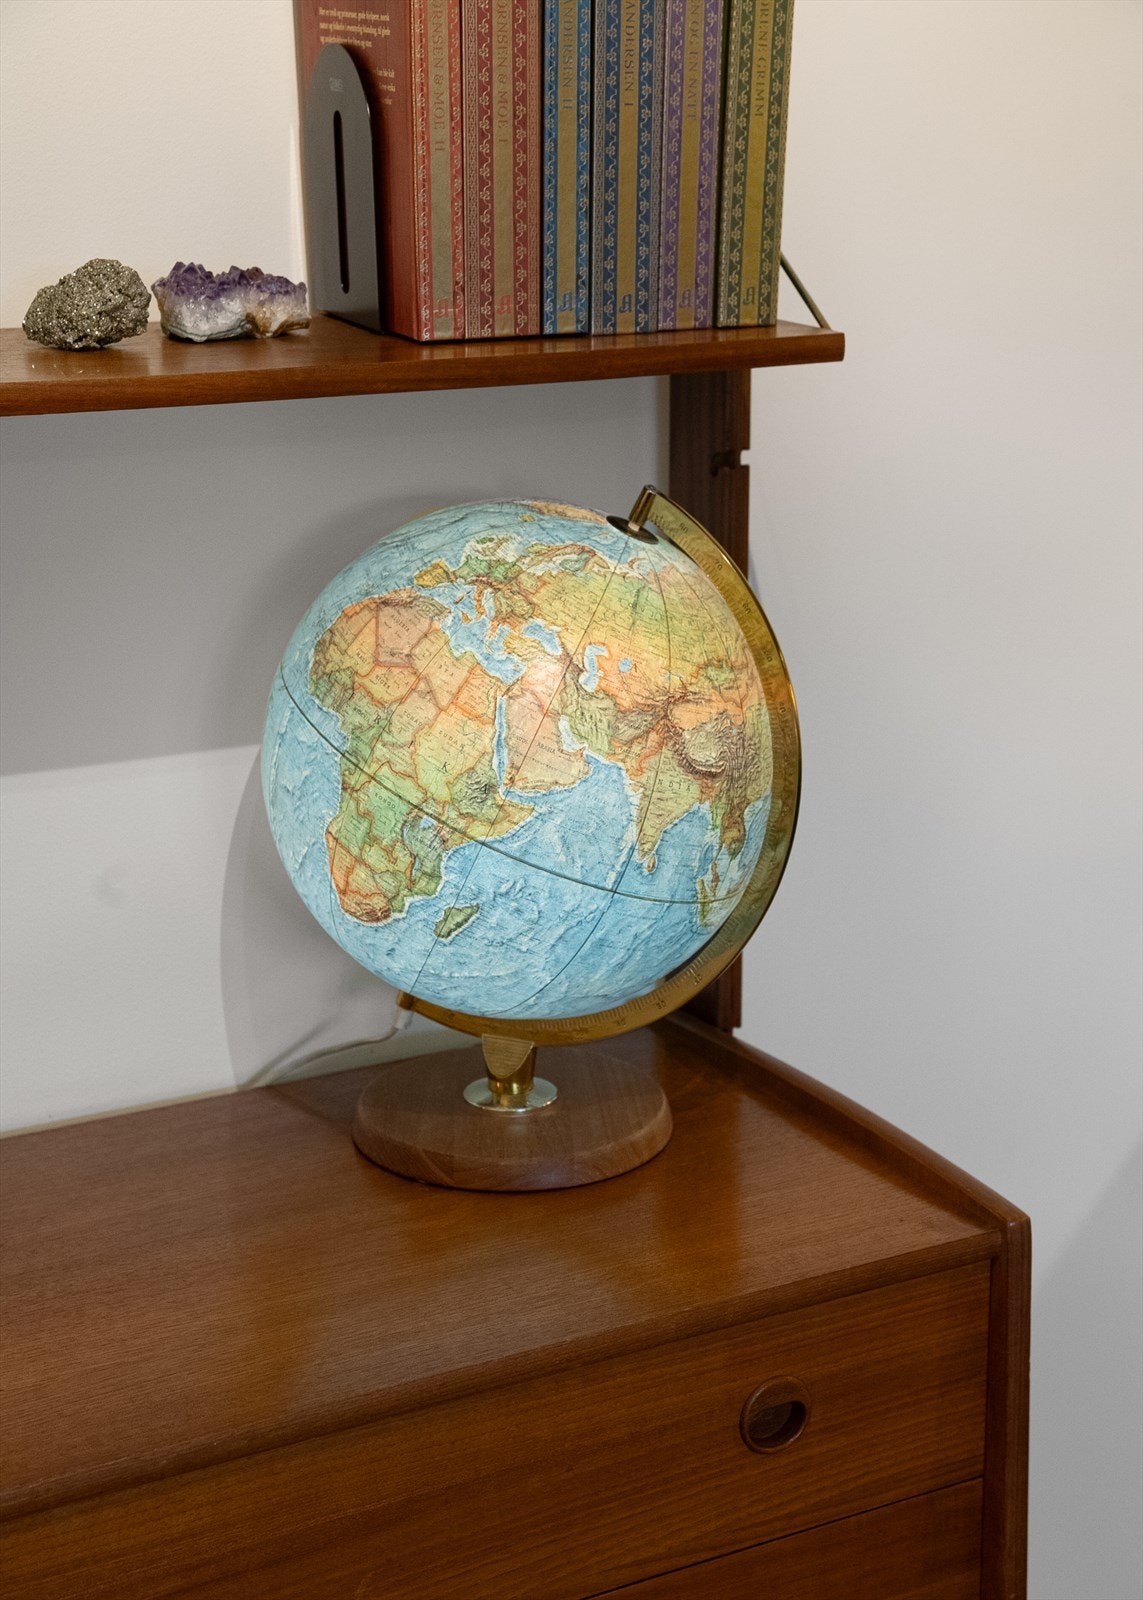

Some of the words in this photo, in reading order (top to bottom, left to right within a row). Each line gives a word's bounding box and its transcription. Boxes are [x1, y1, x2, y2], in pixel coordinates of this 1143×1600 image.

[624, 1, 637, 92] ANDERSEN
[689, 20, 700, 45] OG
[433, 73, 444, 85] &
[688, 51, 699, 72] EN
[687, 78, 698, 121] NATT
[754, 57, 769, 117] GRIMM
[433, 91, 445, 130] MOE
[497, 91, 509, 129] MOE
[373, 792, 397, 809] KONGO
